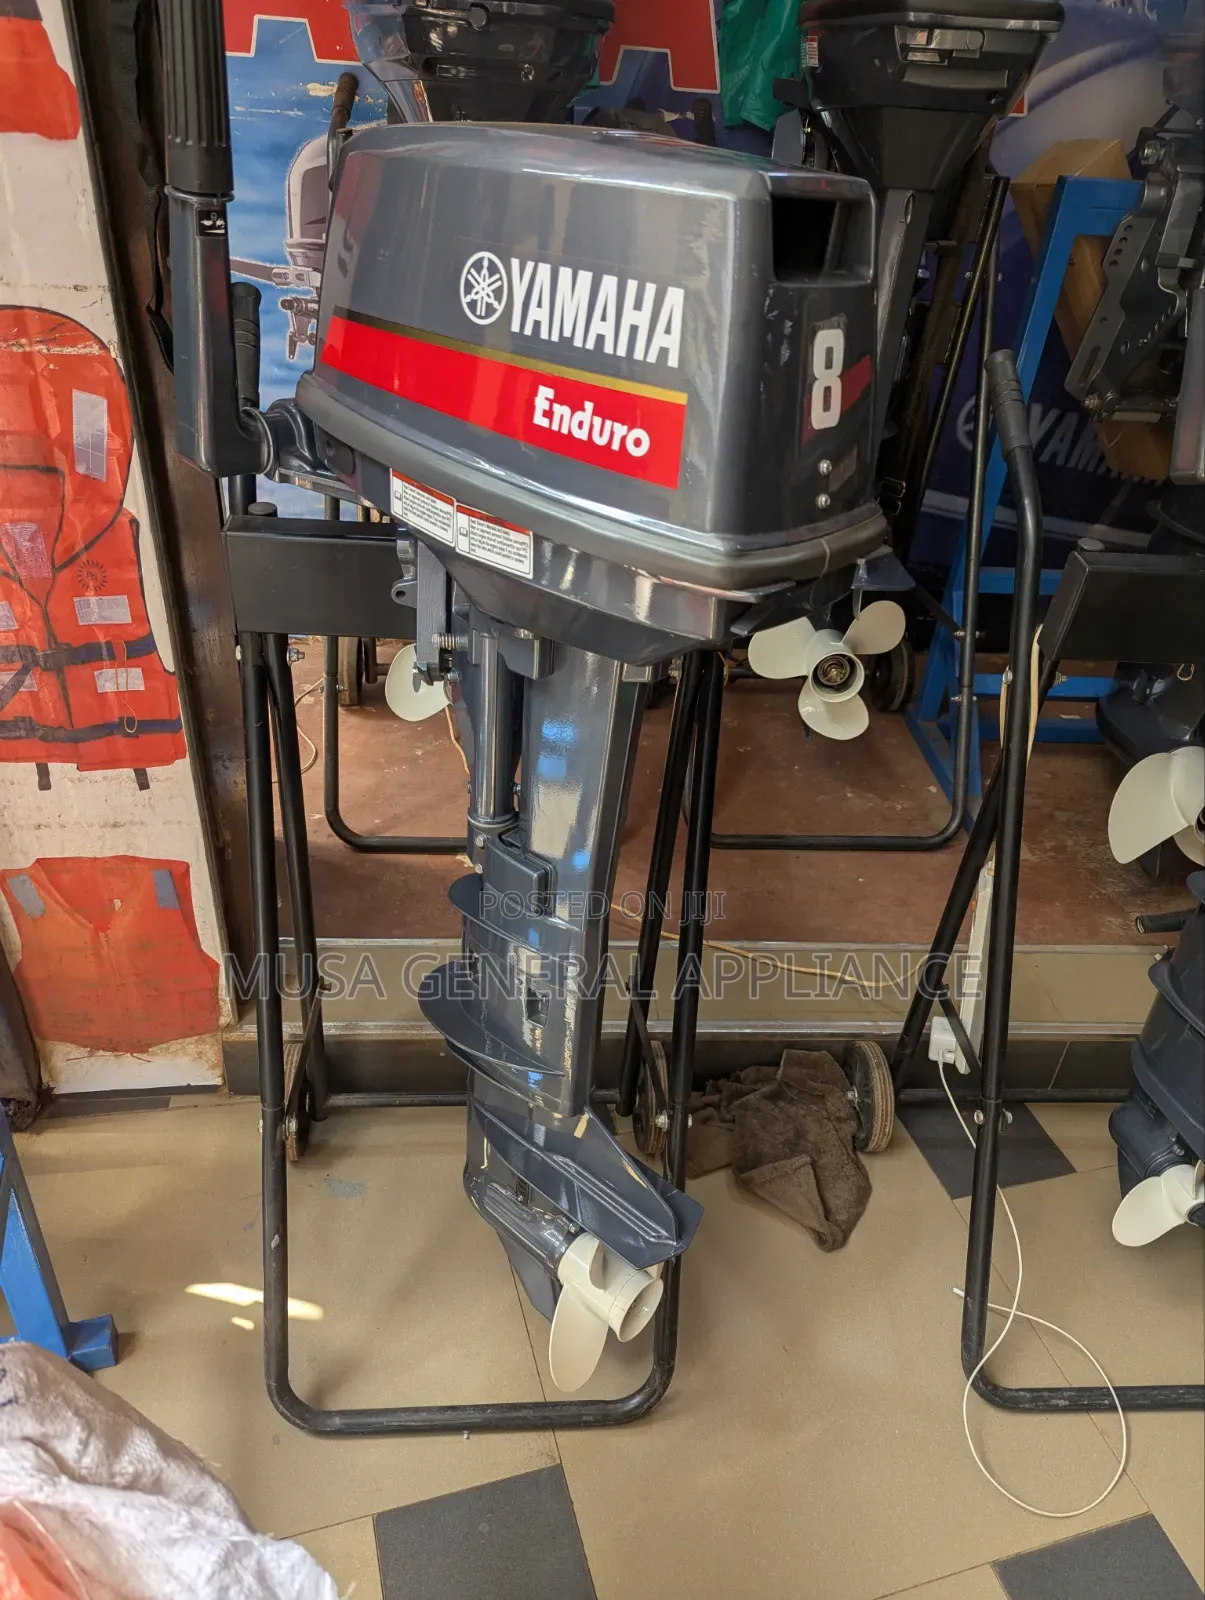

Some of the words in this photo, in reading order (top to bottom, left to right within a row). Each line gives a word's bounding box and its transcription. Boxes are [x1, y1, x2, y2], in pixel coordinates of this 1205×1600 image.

[510, 257, 685, 369] YAMAHA
[532, 384, 651, 458] Enduro
[811, 328, 845, 430] 8
